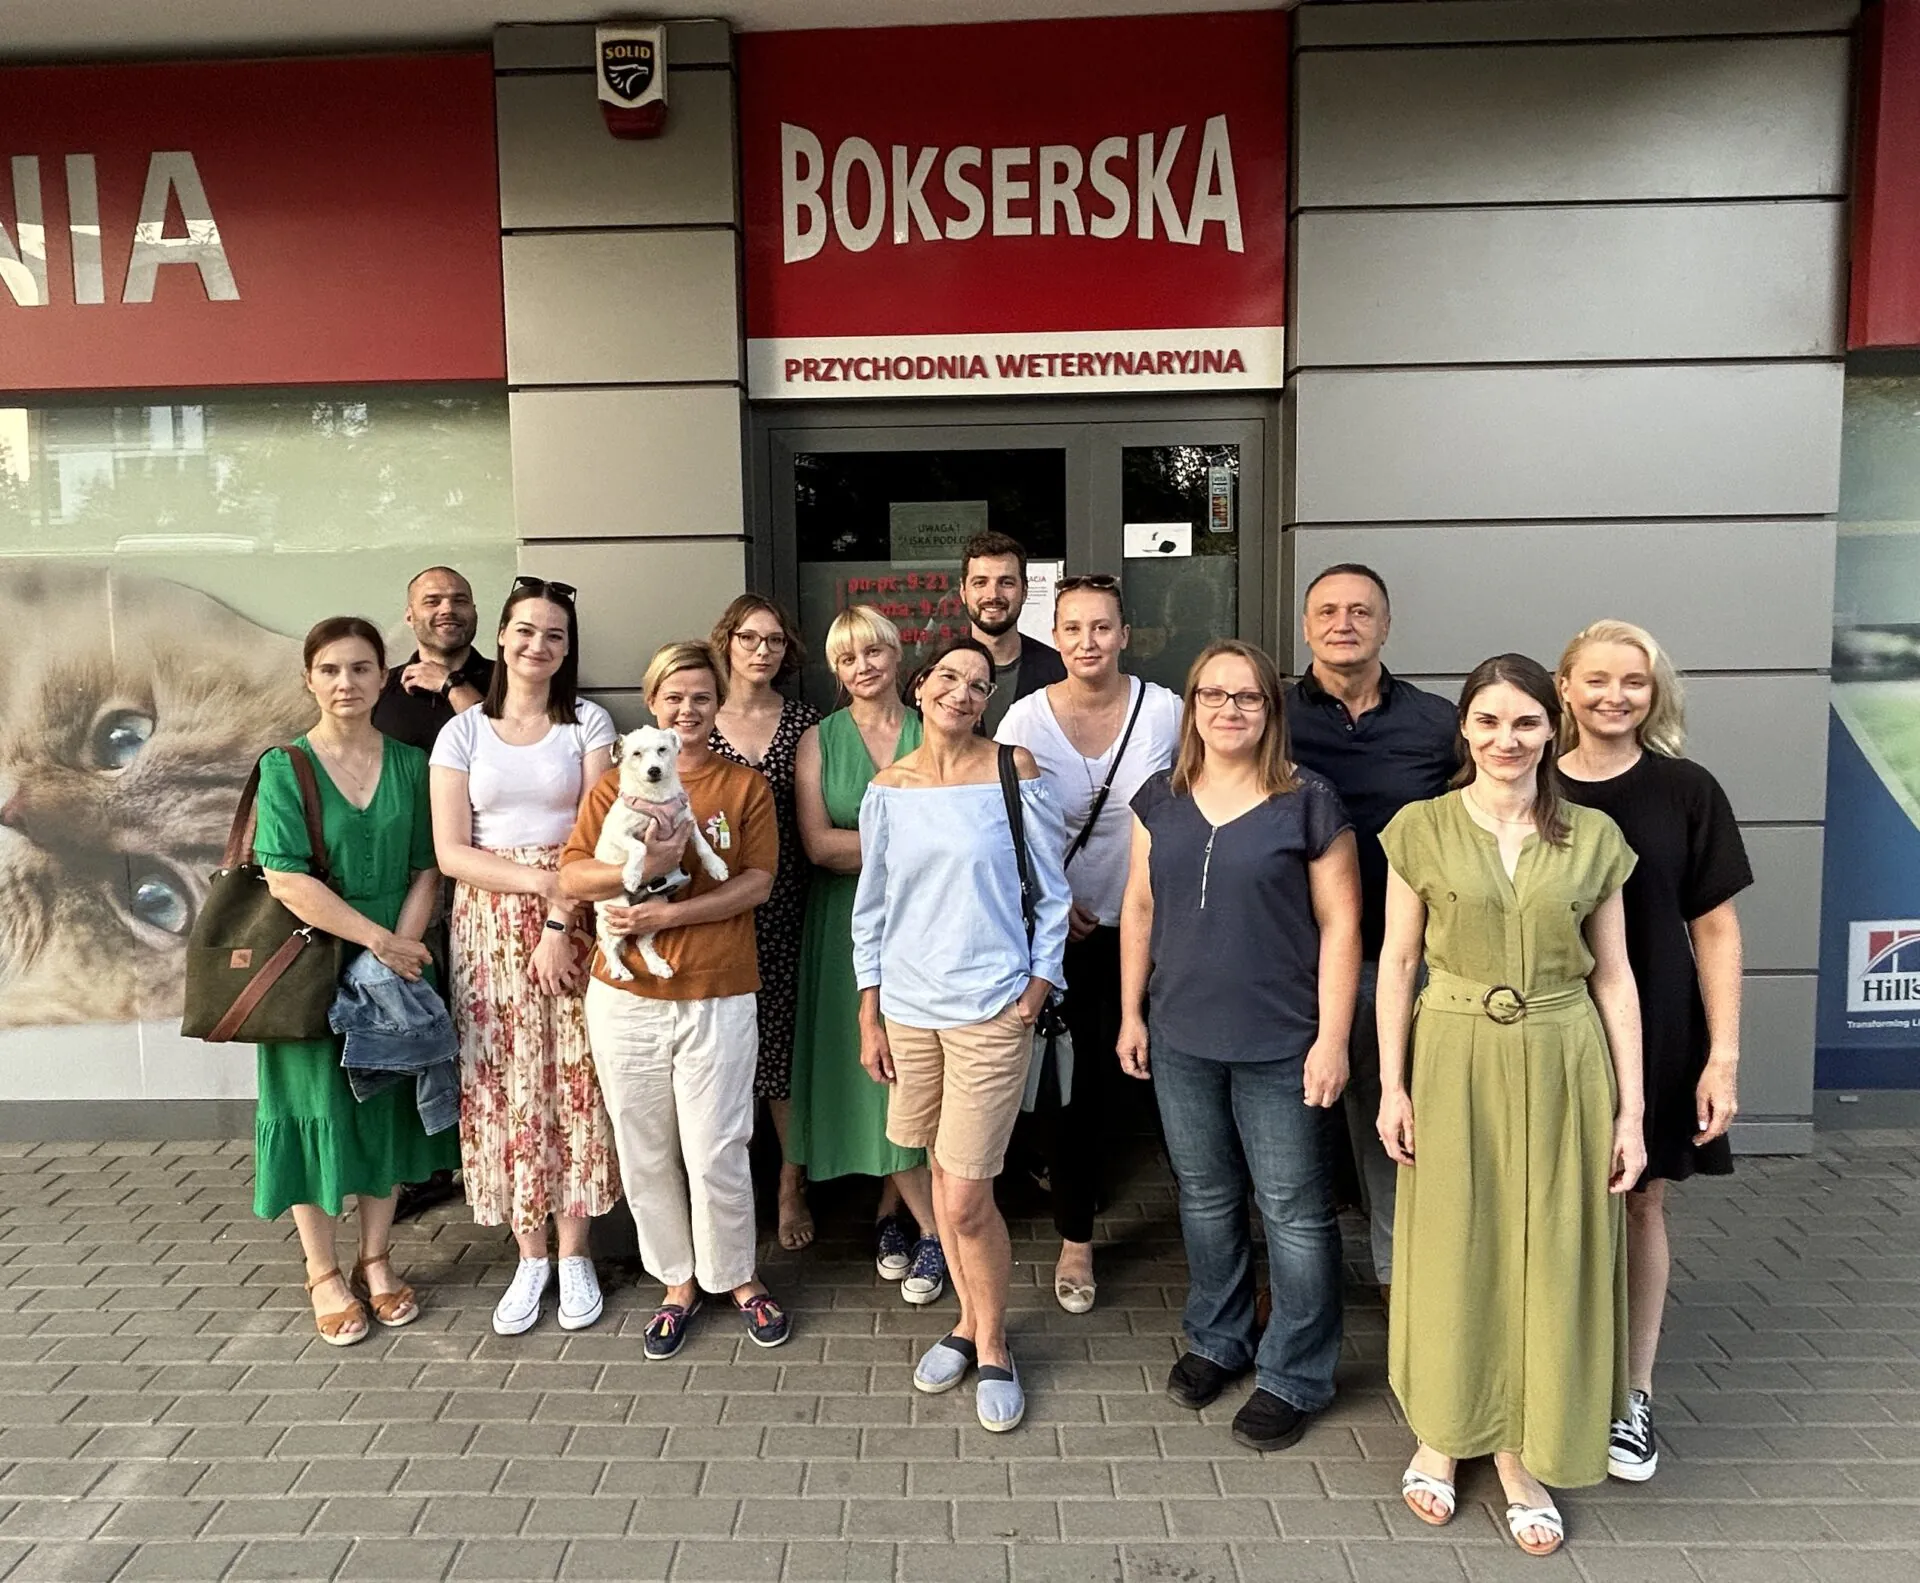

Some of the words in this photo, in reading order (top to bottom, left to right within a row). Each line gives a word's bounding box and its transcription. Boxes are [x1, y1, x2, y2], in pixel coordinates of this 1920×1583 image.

[605, 46, 651, 59] SOLID
[780, 114, 1245, 265] BOKSERSKA
[0, 151, 241, 306] NIA
[785, 354, 989, 382] PRZYCHODNIA
[995, 348, 1246, 379] WETERYNARYJNA
[1863, 979, 1920, 1001] Hill's
